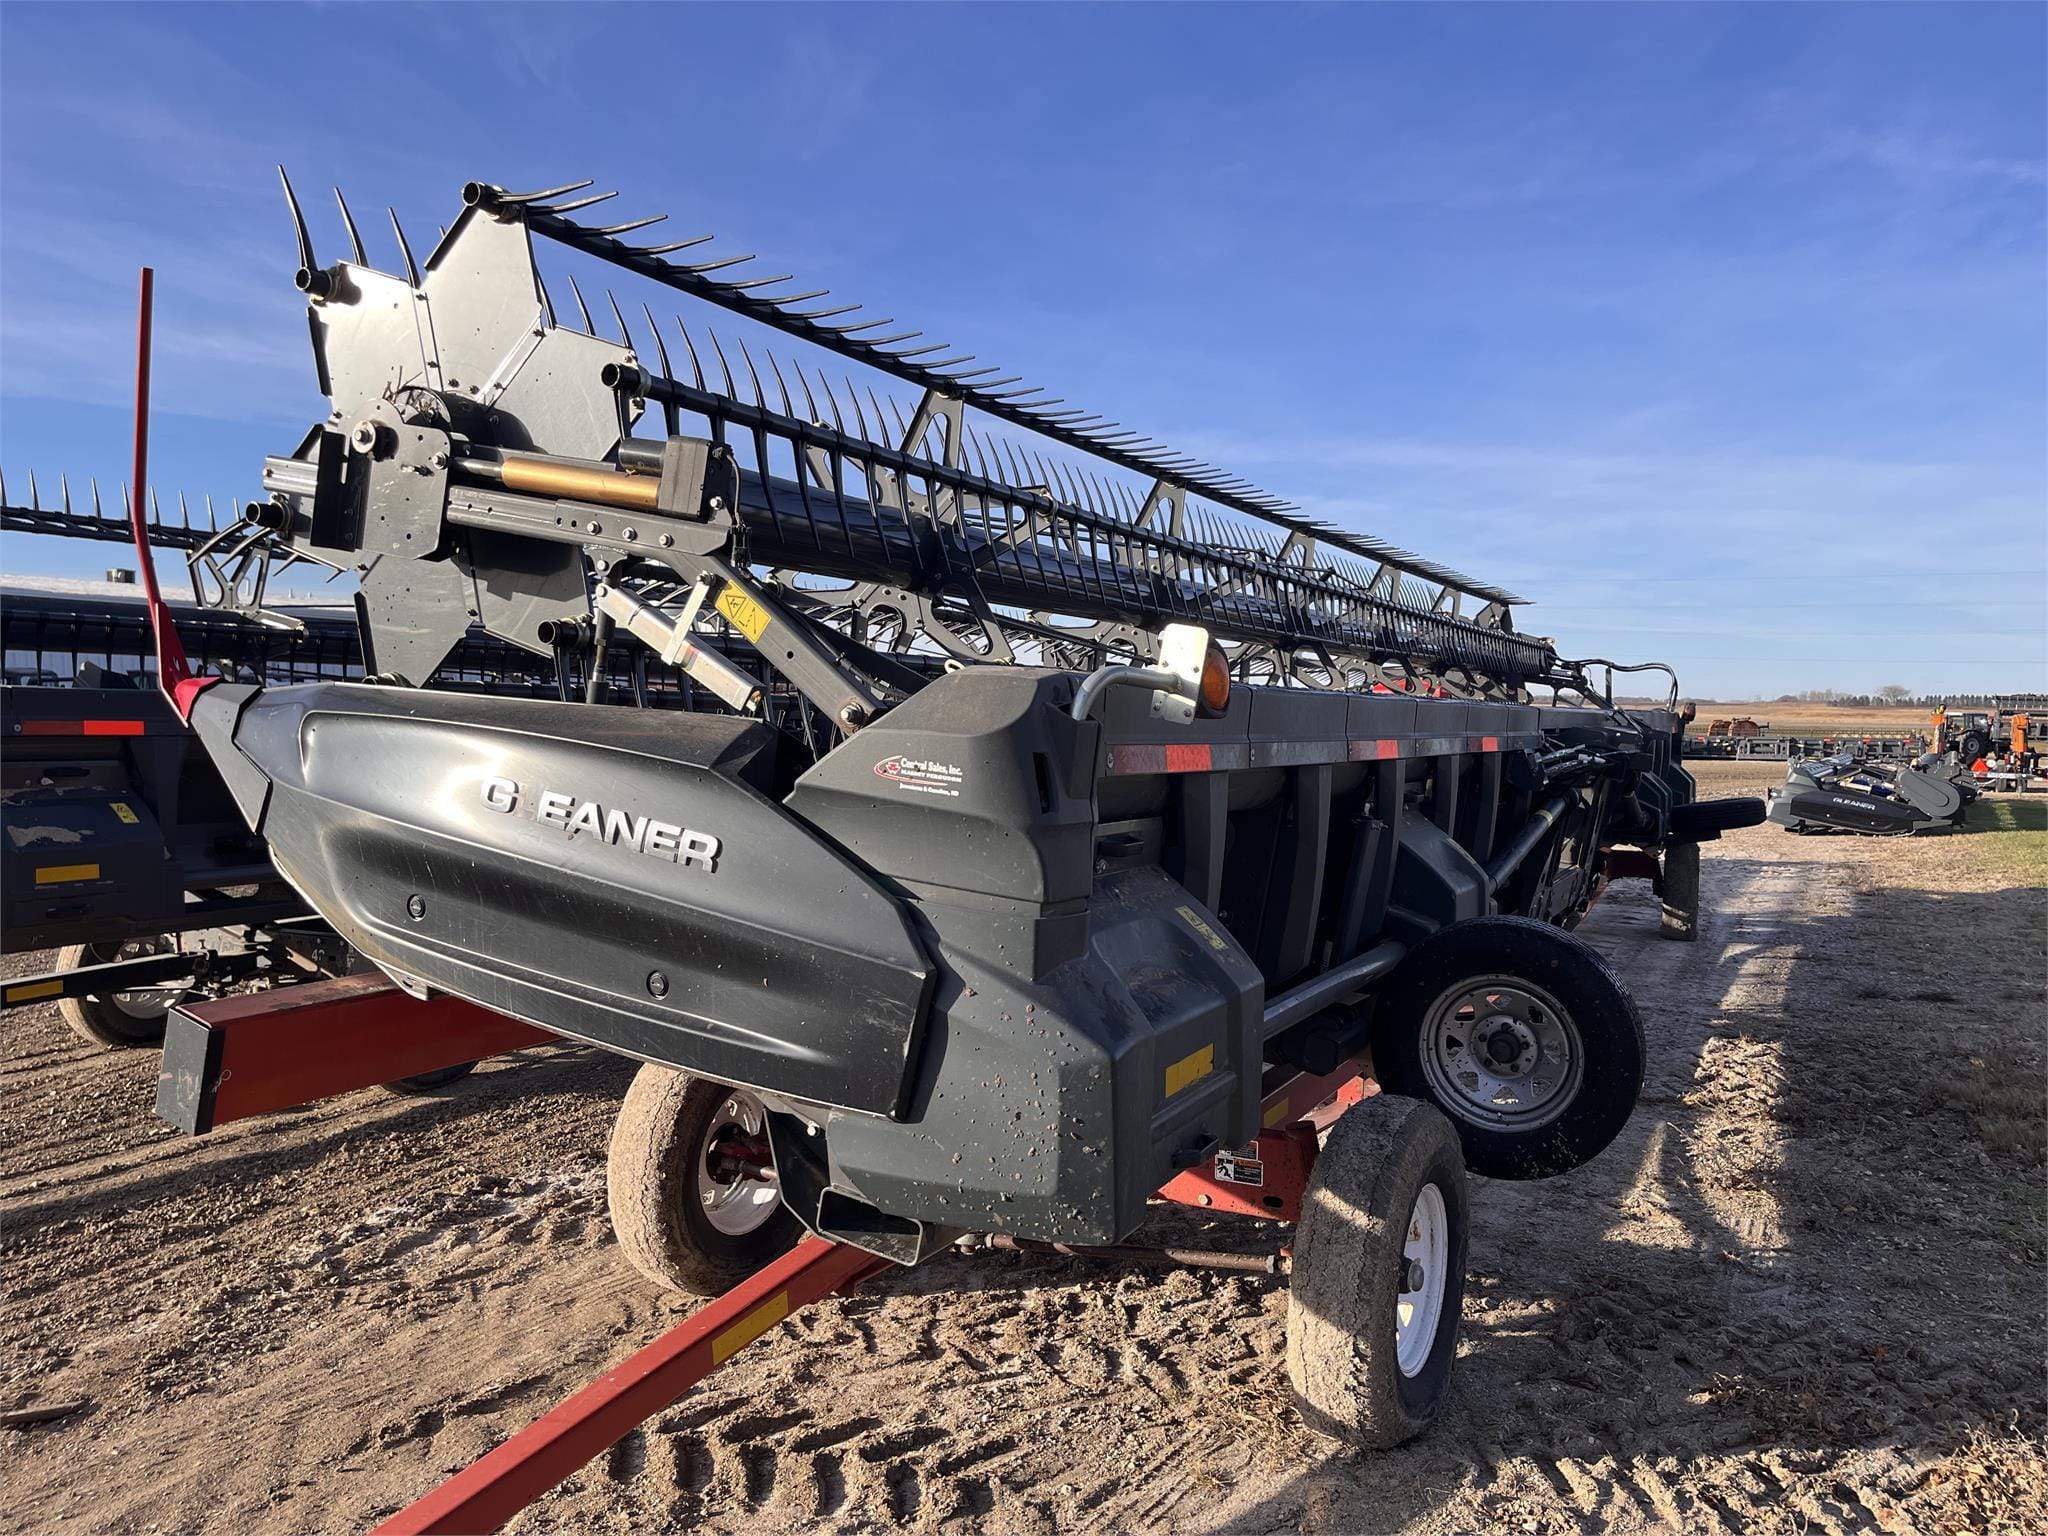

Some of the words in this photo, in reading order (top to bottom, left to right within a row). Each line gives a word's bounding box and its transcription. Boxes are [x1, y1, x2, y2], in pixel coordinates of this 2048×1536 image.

[900, 757, 927, 770] Central
[928, 761, 948, 774] Sales,
[949, 764, 963, 775] Inc.
[926, 773, 962, 782] FERGUSON
[1832, 797, 1876, 810] GLEANER
